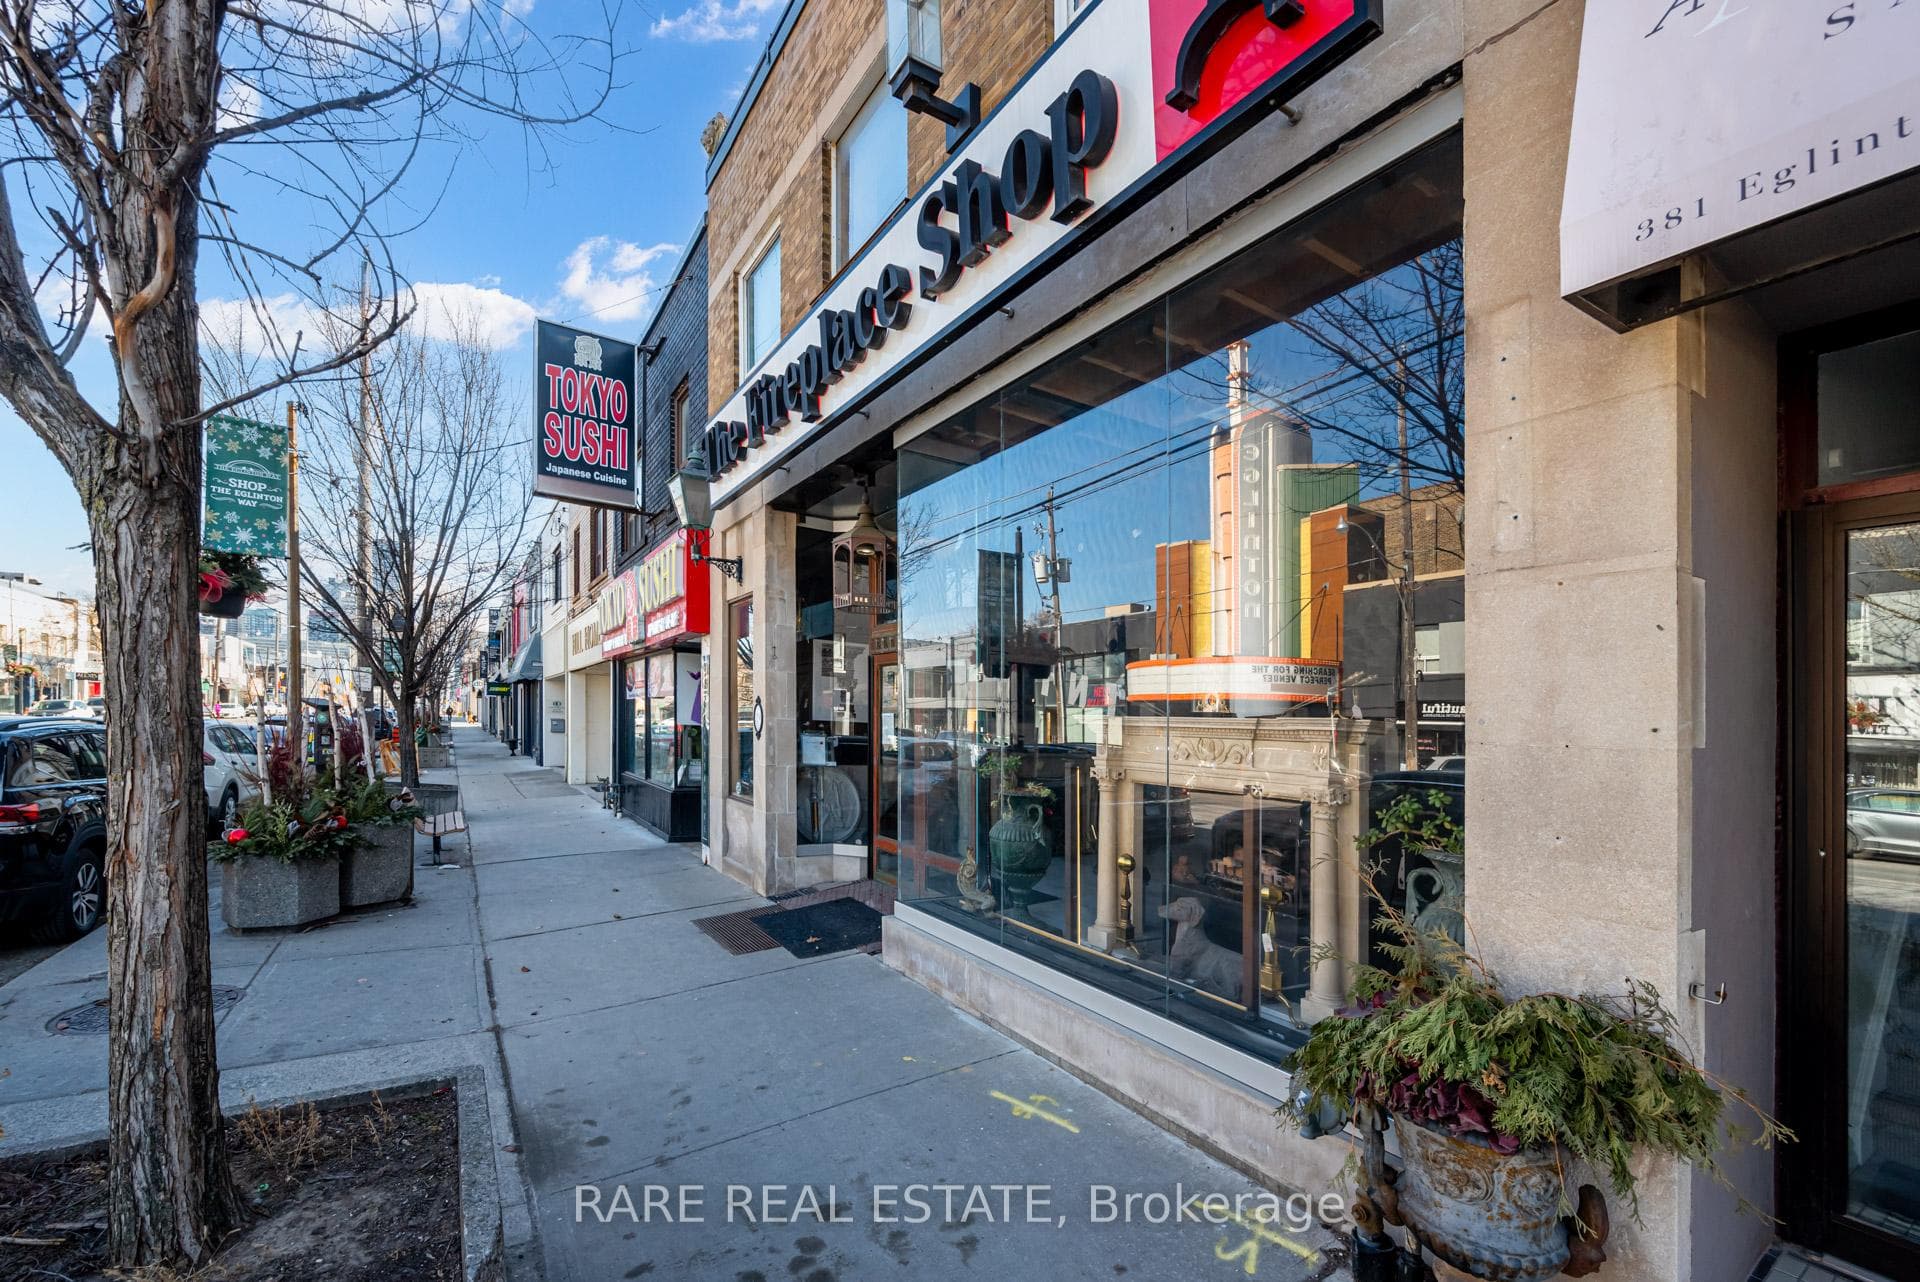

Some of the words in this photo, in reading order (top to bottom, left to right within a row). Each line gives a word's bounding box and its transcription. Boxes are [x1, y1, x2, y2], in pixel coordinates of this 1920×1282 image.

[1635, 197, 1705, 242] 381
[702, 420, 748, 482] The
[743, 264, 913, 449] Fireplace
[917, 69, 1119, 301] Shop
[545, 363, 628, 424] TOKYO
[544, 412, 628, 471] SUSHI
[210, 485, 231, 495] THE
[234, 489, 283, 503] EGLINTON
[228, 478, 267, 492] SHOP
[545, 463, 592, 479] Japanese
[593, 472, 627, 486] Cuisine
[237, 498, 258, 507] WAY
[639, 543, 677, 614] SUSHI
